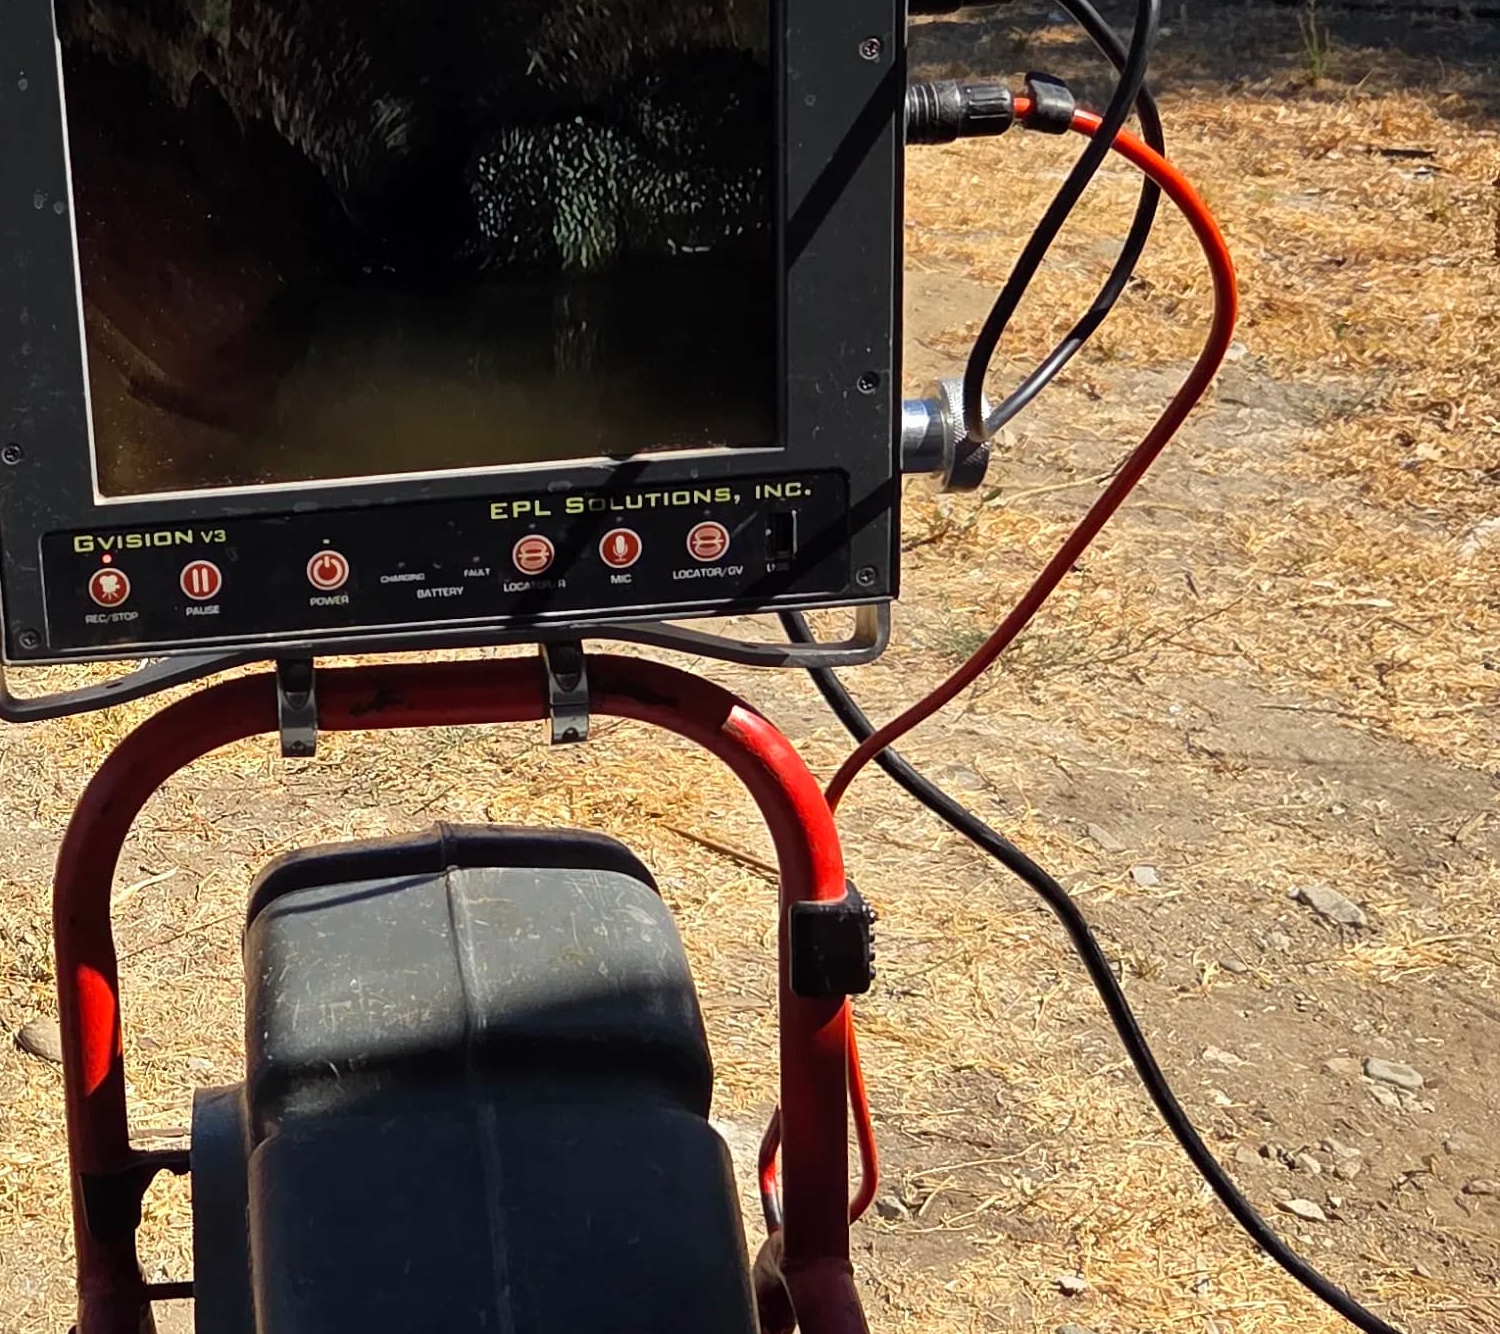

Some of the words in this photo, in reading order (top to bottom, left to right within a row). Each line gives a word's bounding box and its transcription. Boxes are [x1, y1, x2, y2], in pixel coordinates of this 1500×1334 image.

[490, 499, 551, 520] EPL
[565, 487, 741, 514] SOLUTIONS,
[754, 482, 812, 500] INC.
[73, 529, 193, 553] GVISION
[380, 572, 425, 584] CHARGING
[463, 568, 490, 578] FAULT
[610, 573, 632, 585] MIC
[672, 565, 743, 580] LOCATOR/GV
[416, 586, 464, 599] BATTERY
[309, 594, 349, 607] POWER
[185, 604, 220, 617] PAUSE
[85, 611, 139, 624] REC/STOP
